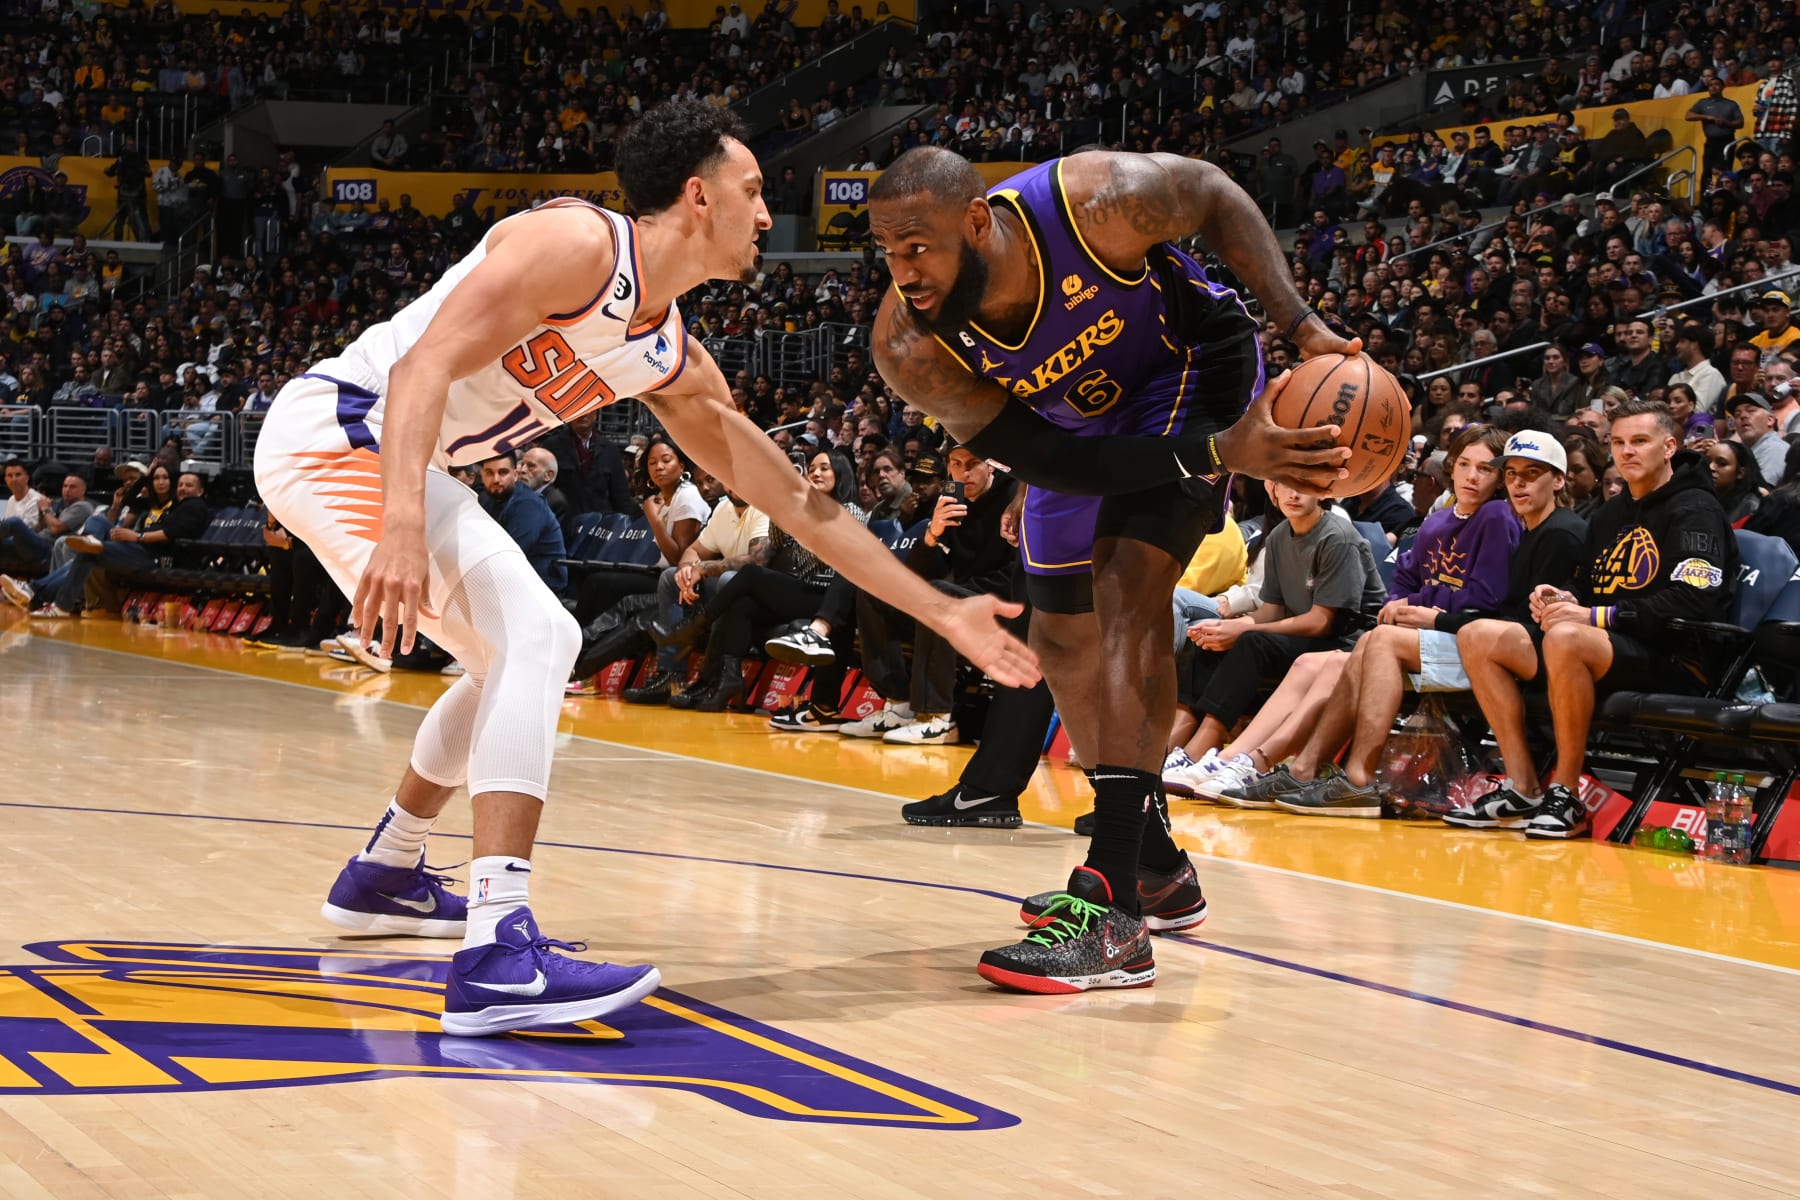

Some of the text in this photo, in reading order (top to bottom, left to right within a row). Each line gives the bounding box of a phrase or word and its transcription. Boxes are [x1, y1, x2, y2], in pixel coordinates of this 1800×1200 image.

[336, 183, 372, 201] 108
[494, 188, 527, 200] LOS
[829, 182, 864, 201] 108
[614, 275, 628, 299] 6
[1064, 284, 1099, 311] bibigo
[959, 331, 976, 348] 6
[643, 351, 669, 374] PayPal
[1063, 369, 1123, 418] 6
[1681, 530, 1721, 557] NBA
[1674, 564, 1721, 583] LAKERS
[609, 661, 628, 677] BIO
